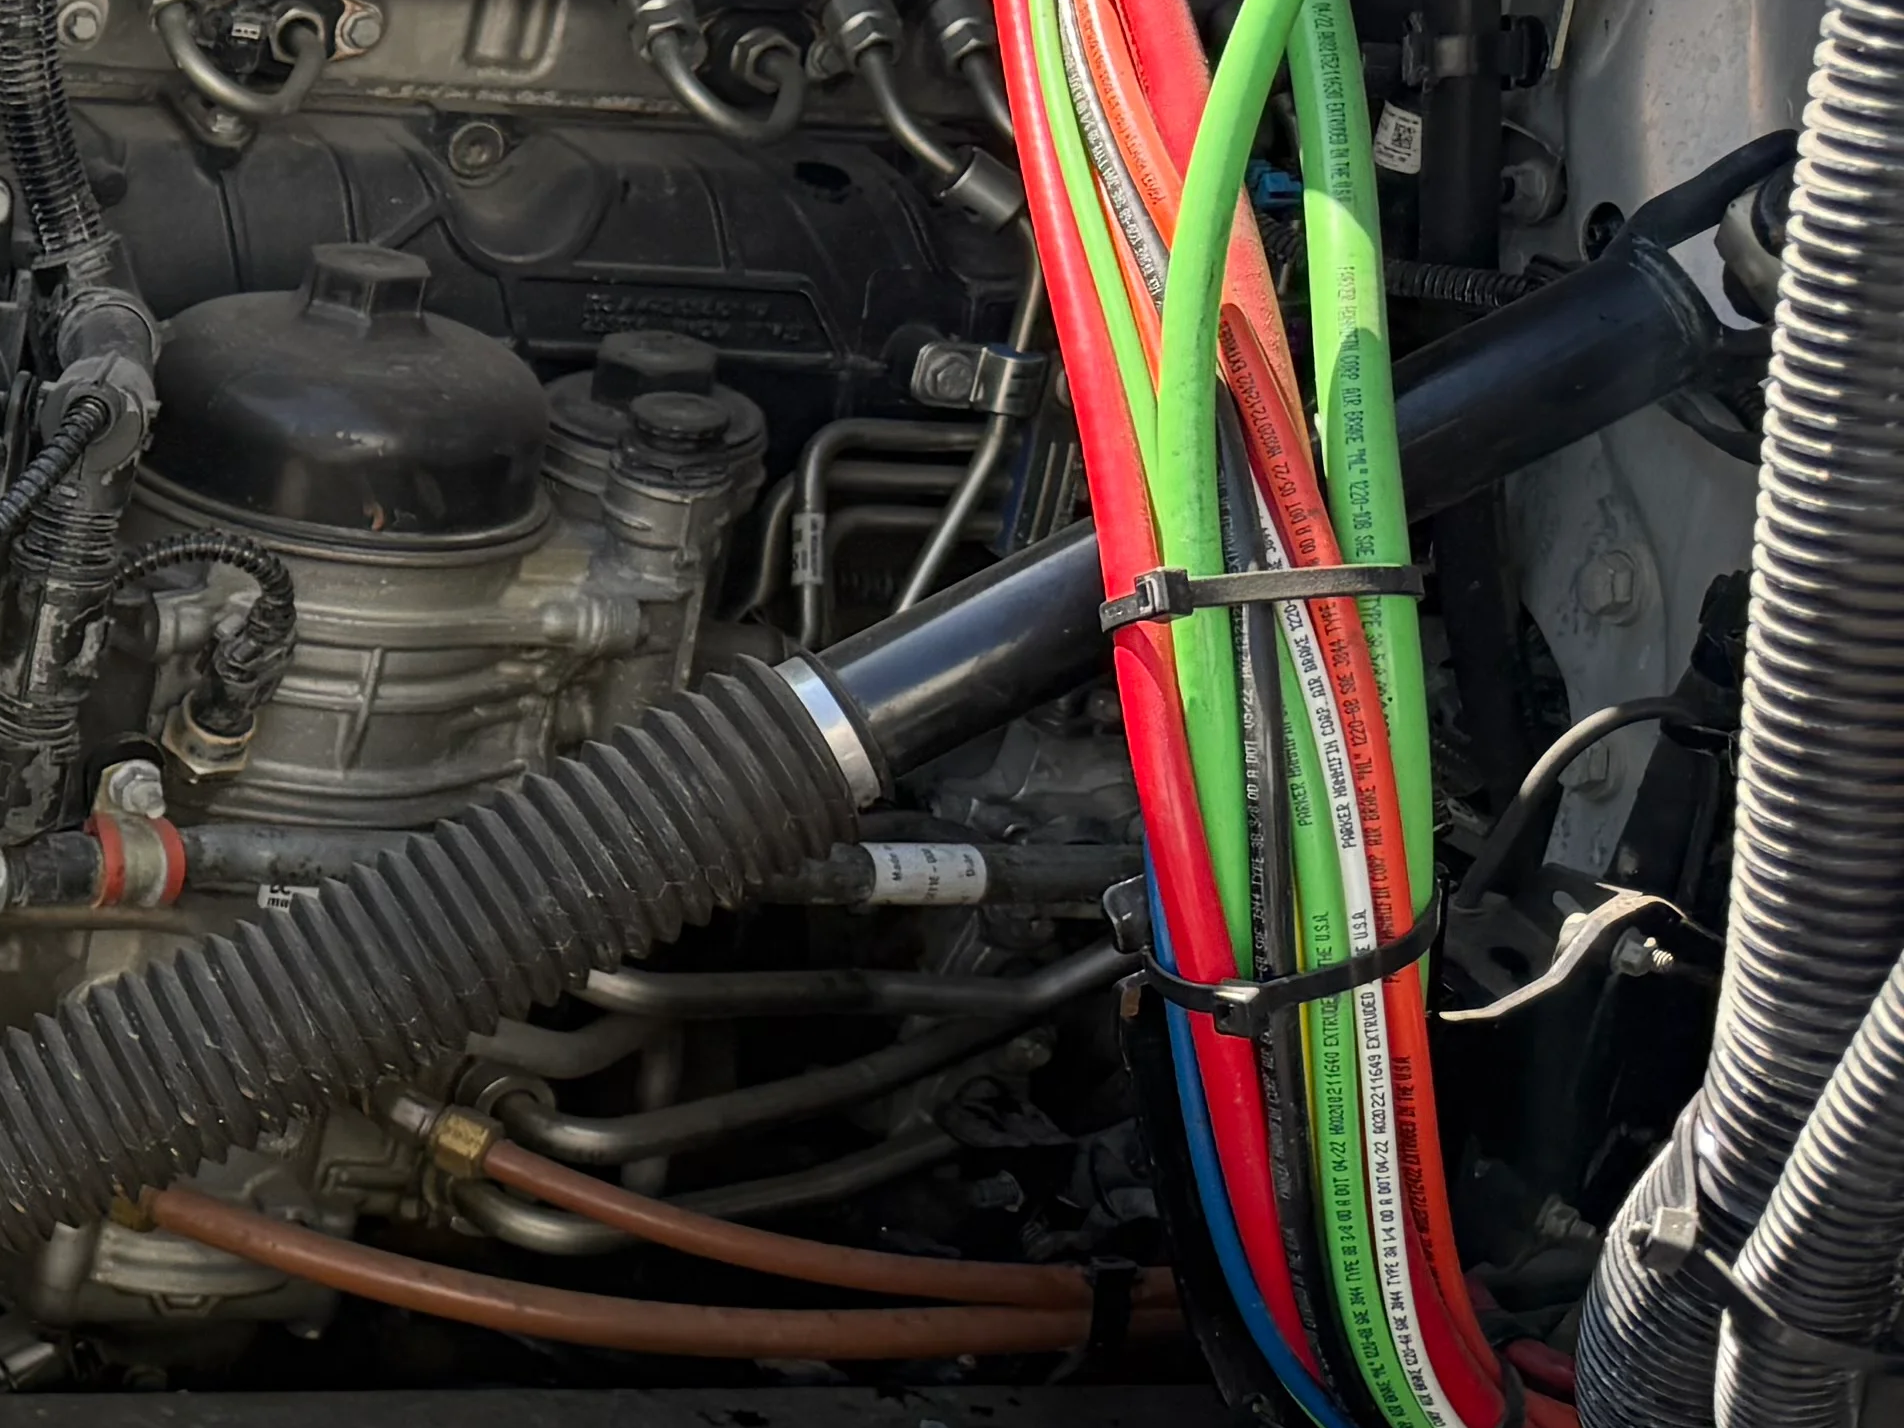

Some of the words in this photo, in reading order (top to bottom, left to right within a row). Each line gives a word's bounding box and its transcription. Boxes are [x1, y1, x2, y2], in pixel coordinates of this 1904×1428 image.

[1294, 638, 1320, 682] BRAKE
[1311, 676, 1327, 699] AIR
[1323, 738, 1349, 801] HANNIFIN
[1336, 801, 1357, 850] PARKER
[1362, 990, 1381, 1052] EXTRUDED
[1376, 1139, 1389, 1174] 04/22
